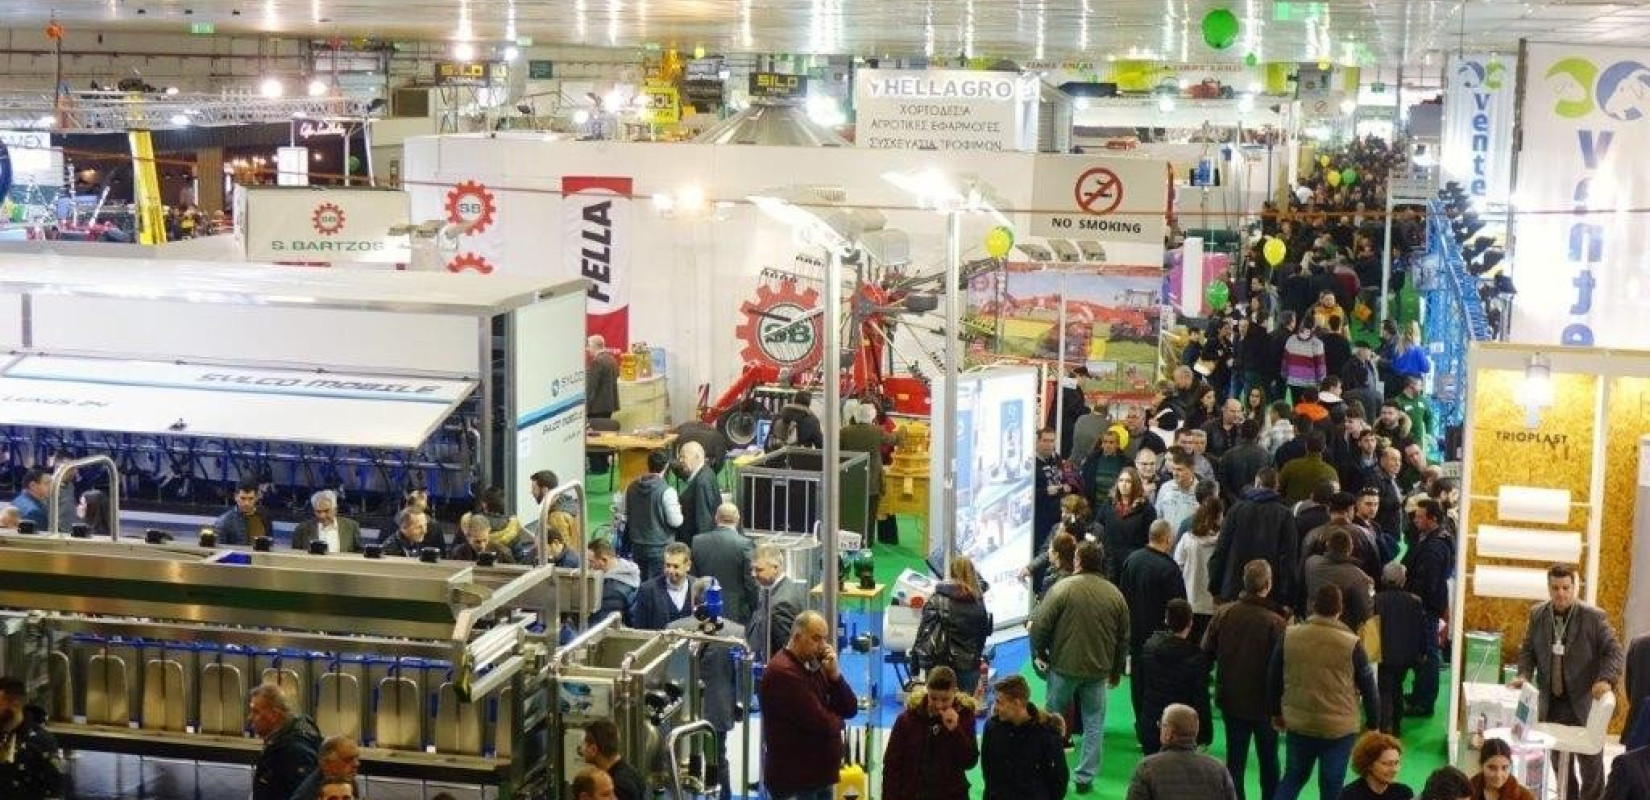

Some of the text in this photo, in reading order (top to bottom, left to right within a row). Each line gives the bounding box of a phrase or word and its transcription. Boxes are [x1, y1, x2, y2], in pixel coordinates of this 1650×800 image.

[884, 79, 1013, 97] HELLAGRO
[1471, 93, 1490, 196] vente
[1051, 217, 1142, 234] NO SMOKING
[581, 200, 613, 304] FELLA
[1496, 430, 1568, 446] TRIOPLAST
